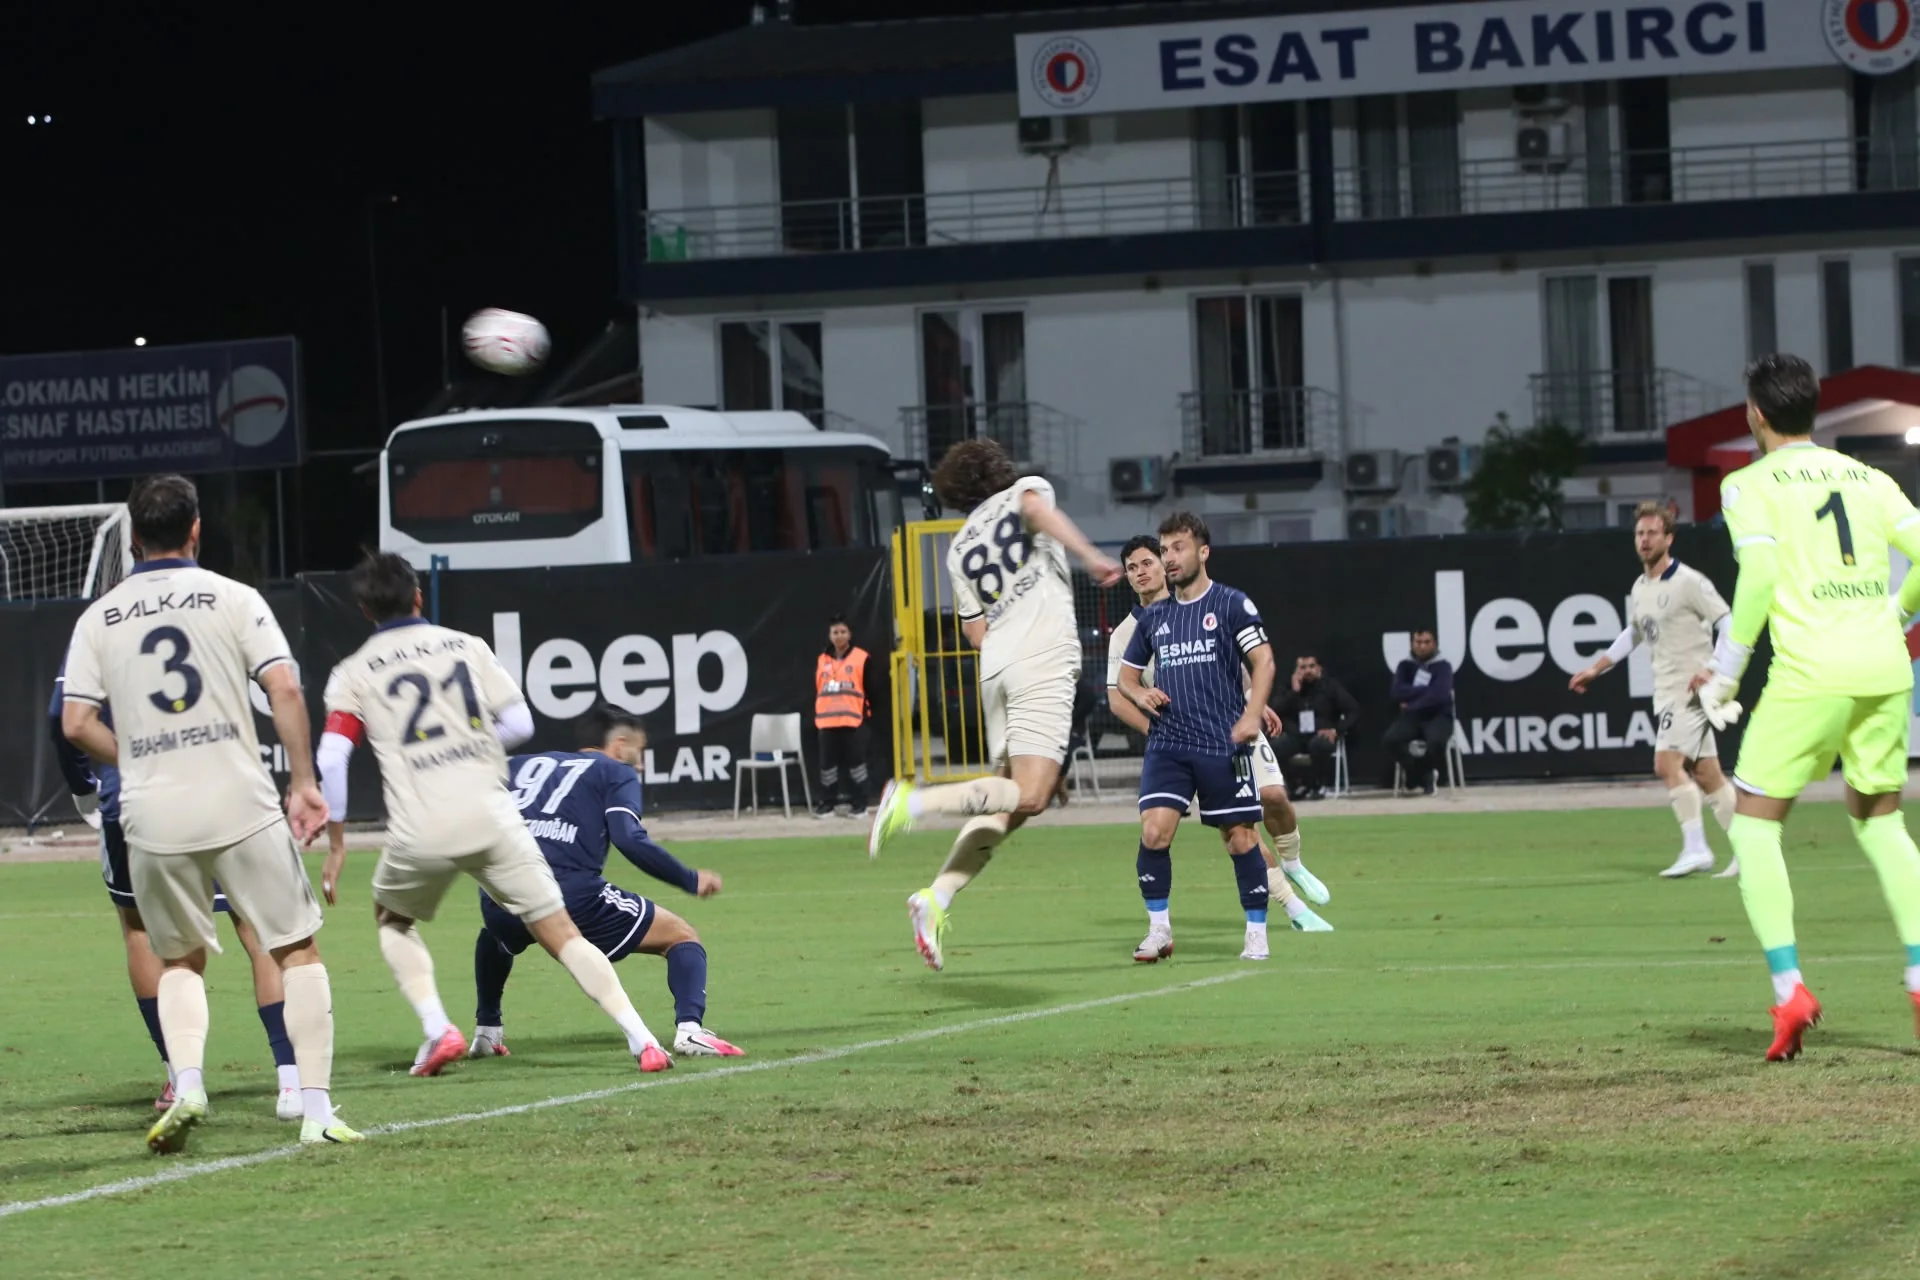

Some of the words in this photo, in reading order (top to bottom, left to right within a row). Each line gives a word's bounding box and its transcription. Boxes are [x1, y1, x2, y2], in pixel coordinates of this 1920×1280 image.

[1159, 26, 1369, 91] ESAT
[1414, 1, 1766, 74] BAKIRCI
[119, 365, 209, 399] HEKİM
[77, 402, 212, 435] HASTANESİ
[1815, 490, 1857, 566] 1
[963, 512, 1031, 604] 88
[104, 592, 217, 626] BALKAR
[140, 626, 203, 714] 3
[1160, 639, 1216, 658] ESNAF
[388, 661, 481, 744] 21
[1454, 711, 1656, 755] AKIRCILA
[511, 756, 596, 814] 97
